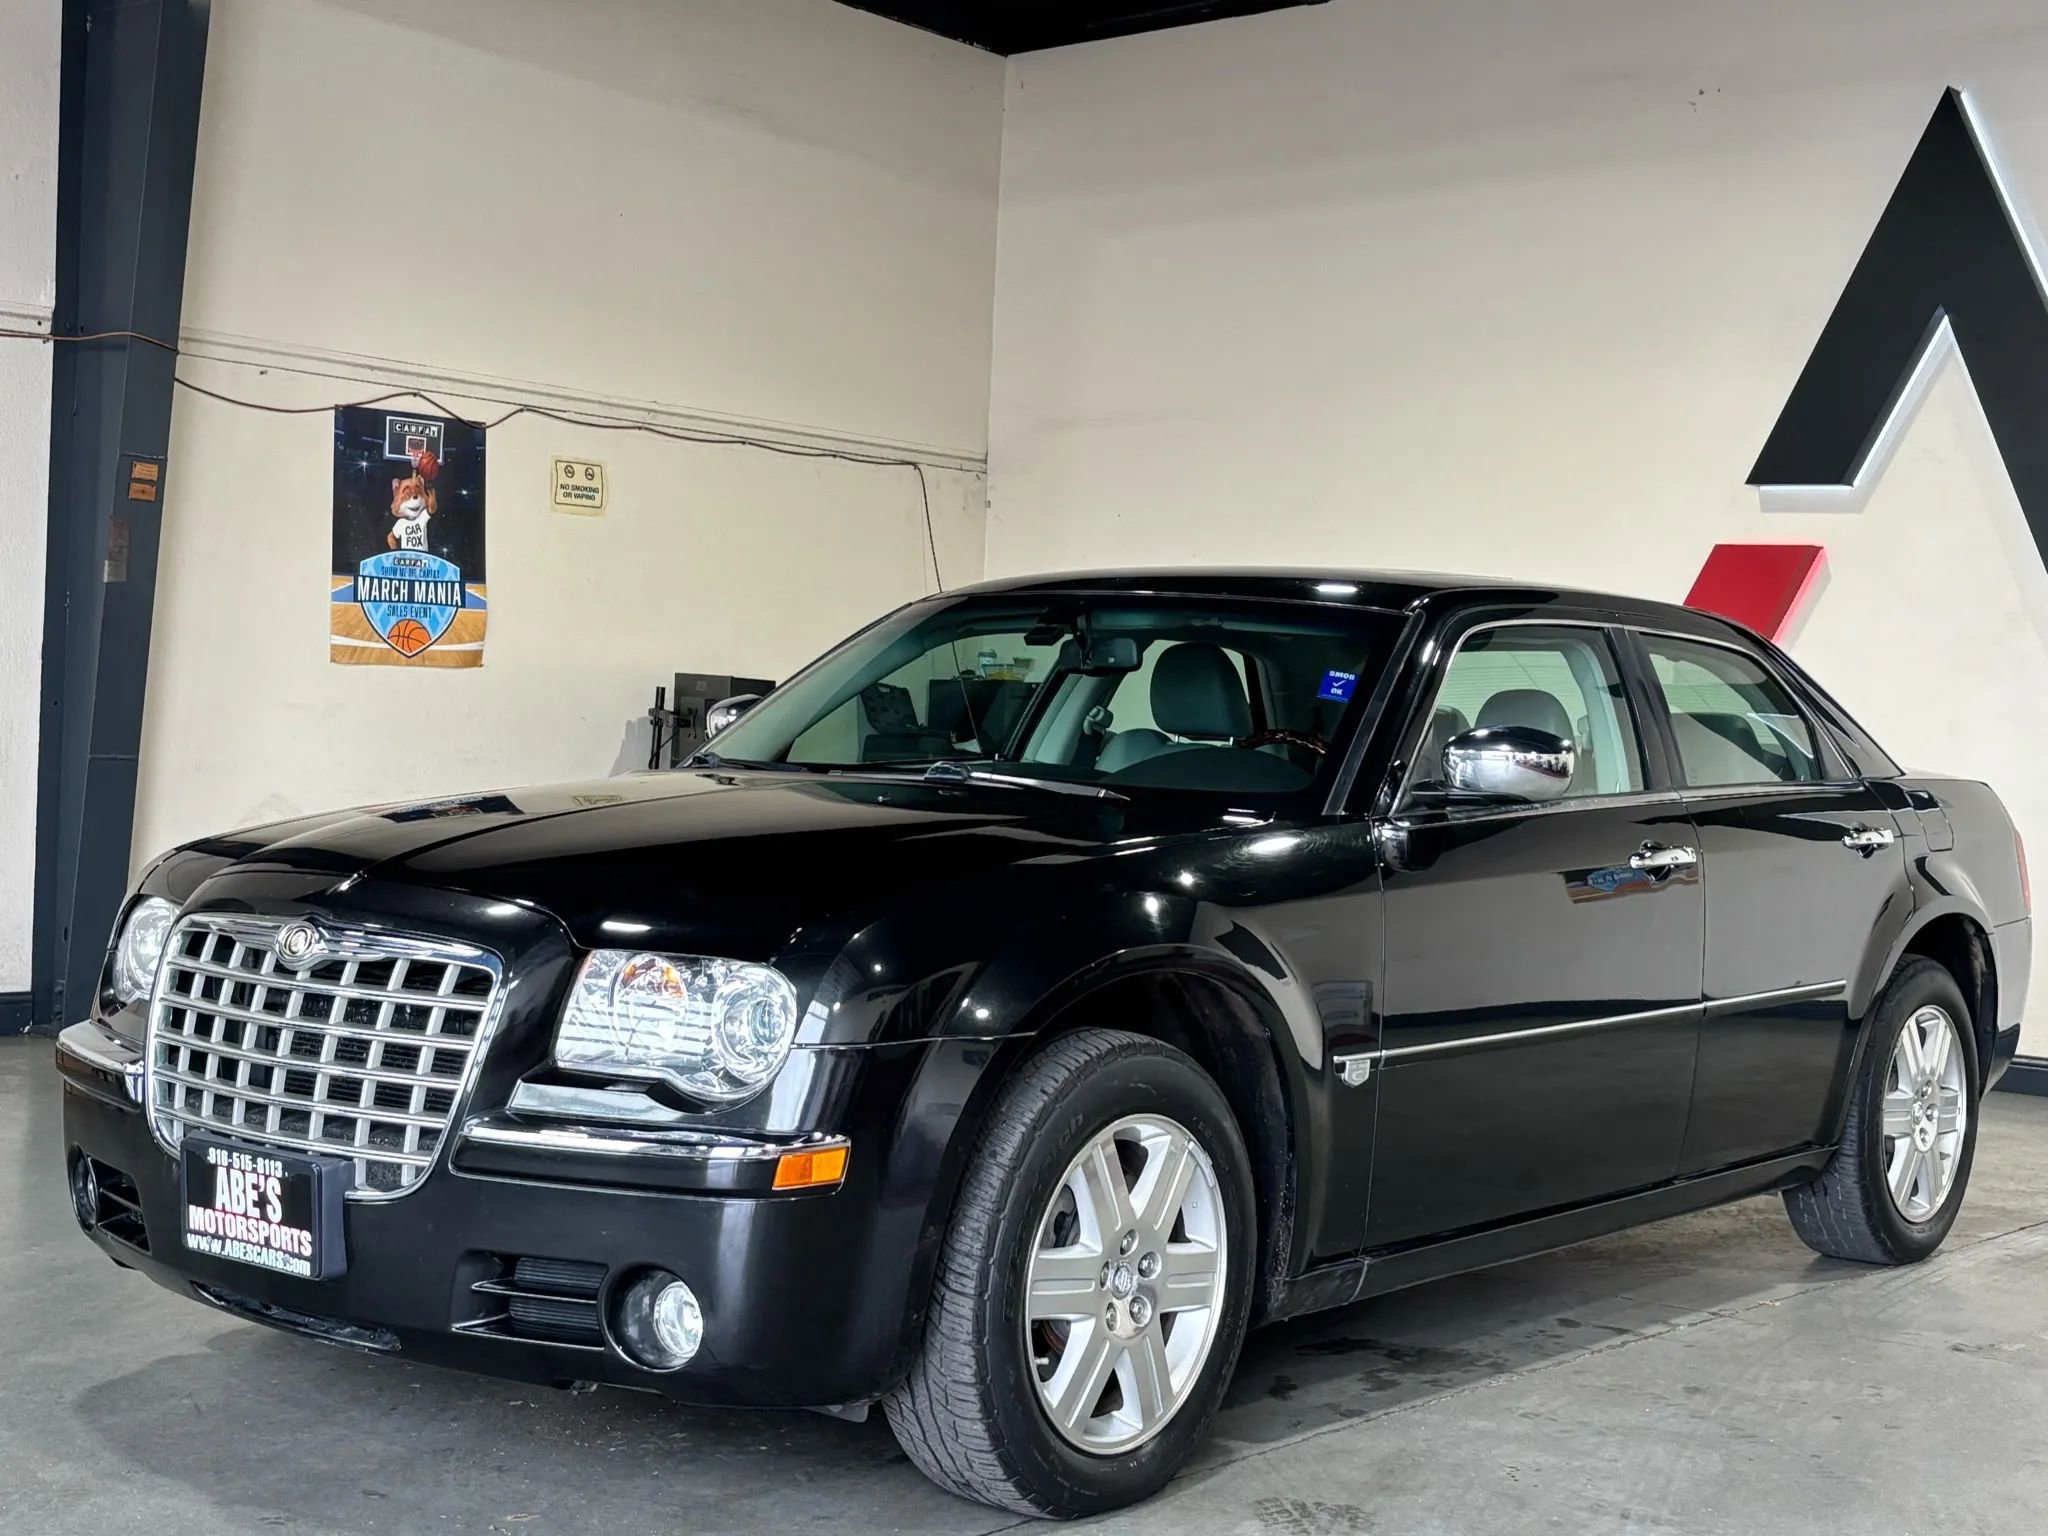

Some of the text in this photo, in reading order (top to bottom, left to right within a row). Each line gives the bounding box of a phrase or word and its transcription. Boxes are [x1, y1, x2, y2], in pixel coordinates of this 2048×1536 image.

[394, 422, 438, 437] CARFAX
[563, 491, 596, 501] OR VAPING
[571, 485, 600, 494] SMOKING
[405, 523, 422, 536] CAR
[406, 535, 422, 547] FOX
[358, 577, 461, 606] MARCH MANIA
[387, 604, 432, 619] SALES EVENT
[215, 1166, 283, 1224] ABE'S
[188, 1204, 313, 1257] MOTORSPORTS
